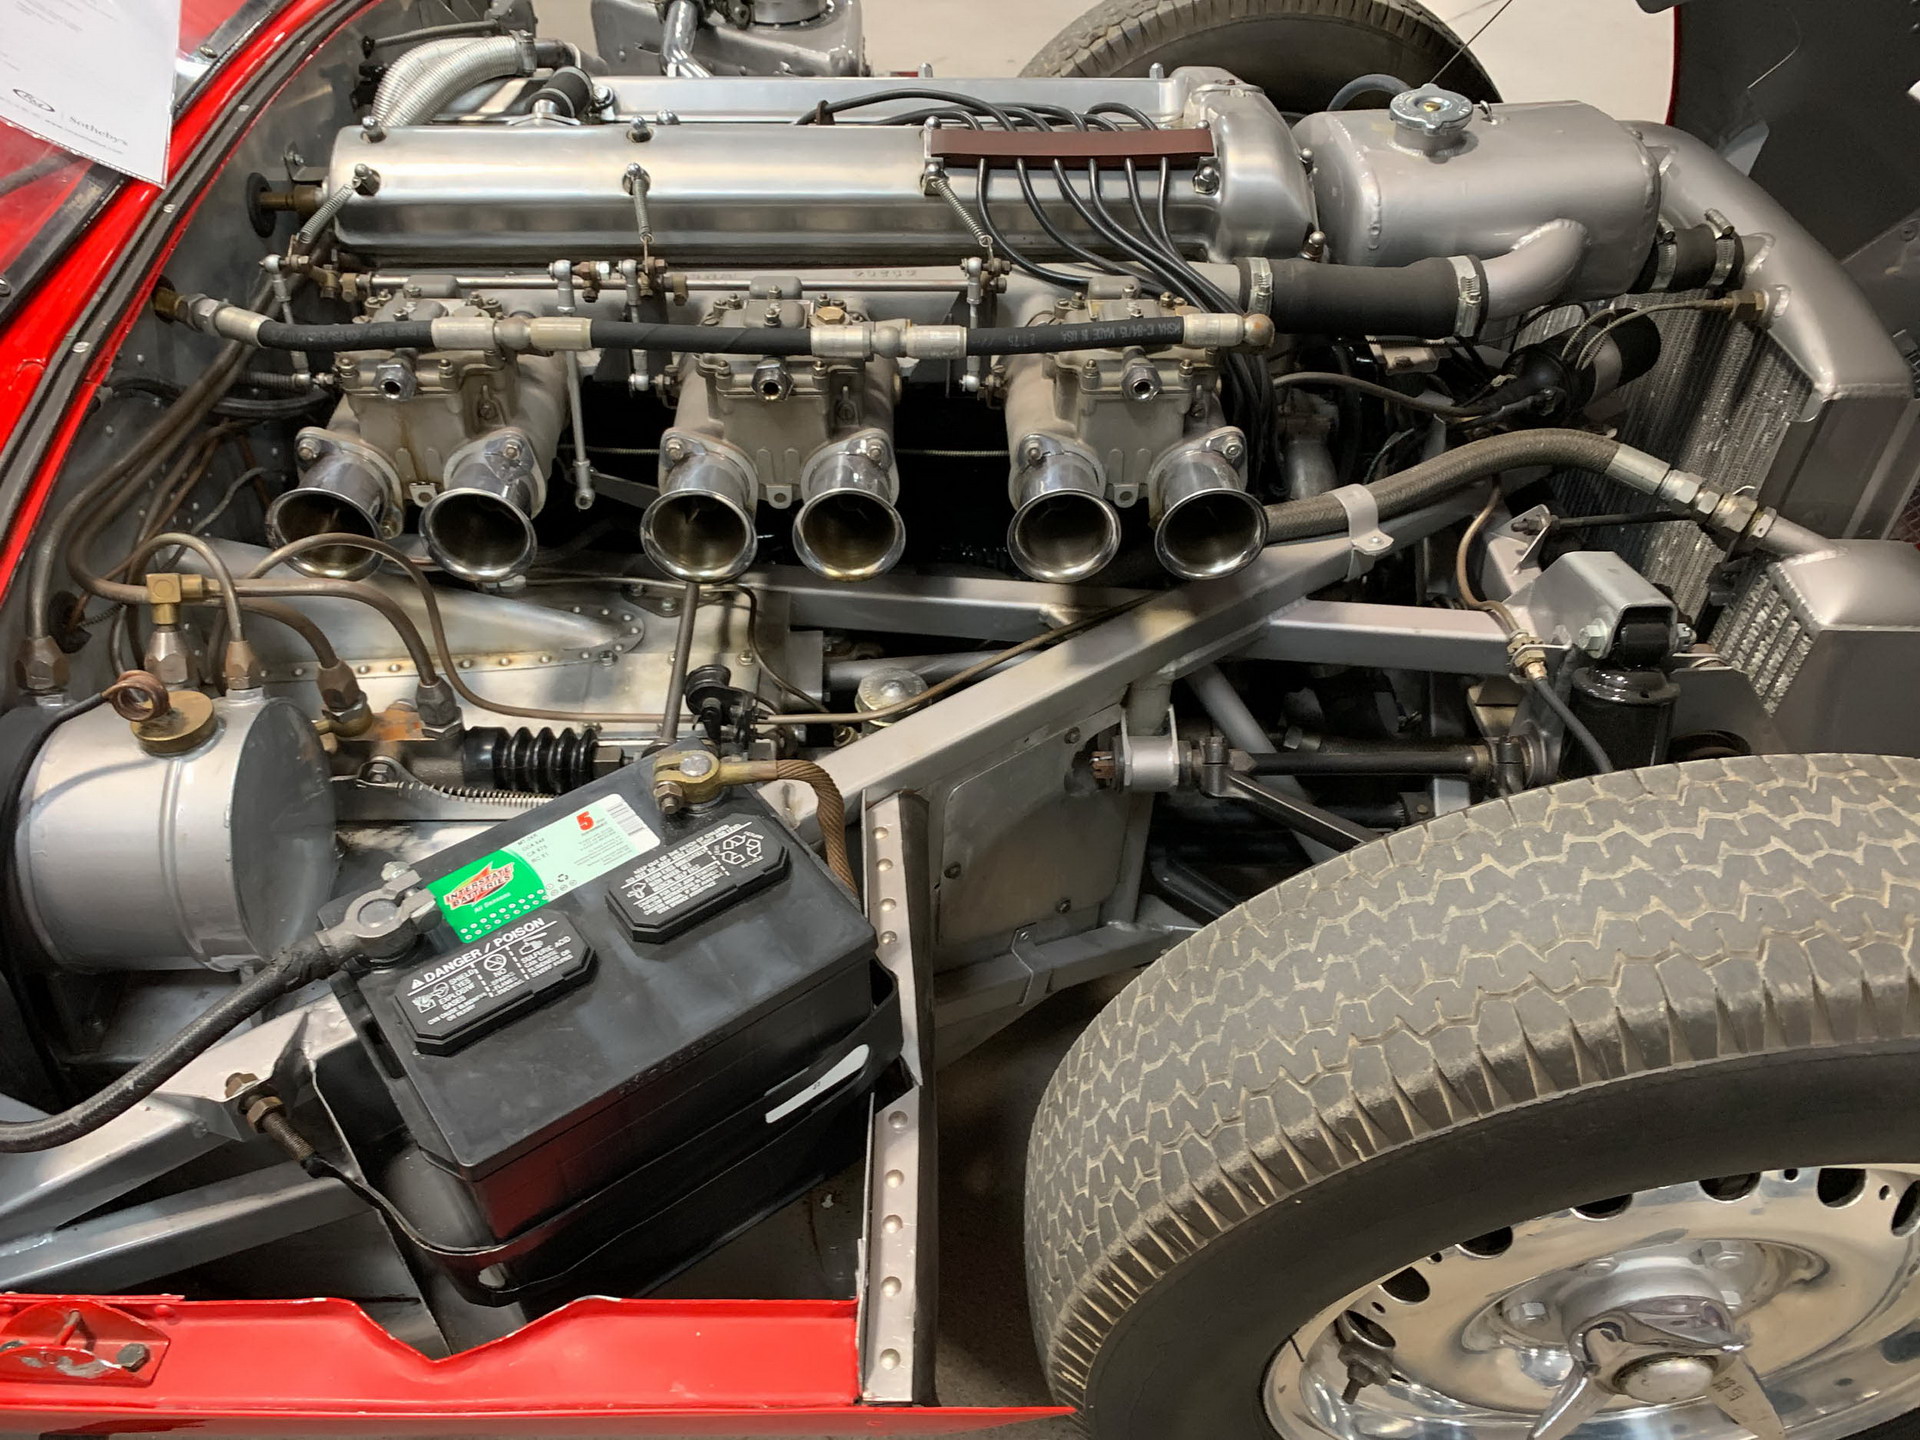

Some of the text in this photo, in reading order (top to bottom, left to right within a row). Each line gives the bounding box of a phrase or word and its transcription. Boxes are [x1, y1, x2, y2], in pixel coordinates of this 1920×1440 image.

[1092, 326, 1116, 340] MADE
[576, 811, 594, 831] 5
[445, 864, 512, 903] INTERSTATE
[451, 873, 512, 908] BATTERIES
[423, 949, 483, 983] DANGER
[494, 918, 545, 948] POISON
[553, 935, 572, 948] ACID
[448, 968, 475, 986] SHIELD
[493, 968, 507, 978] NO
[452, 977, 472, 991] EYES
